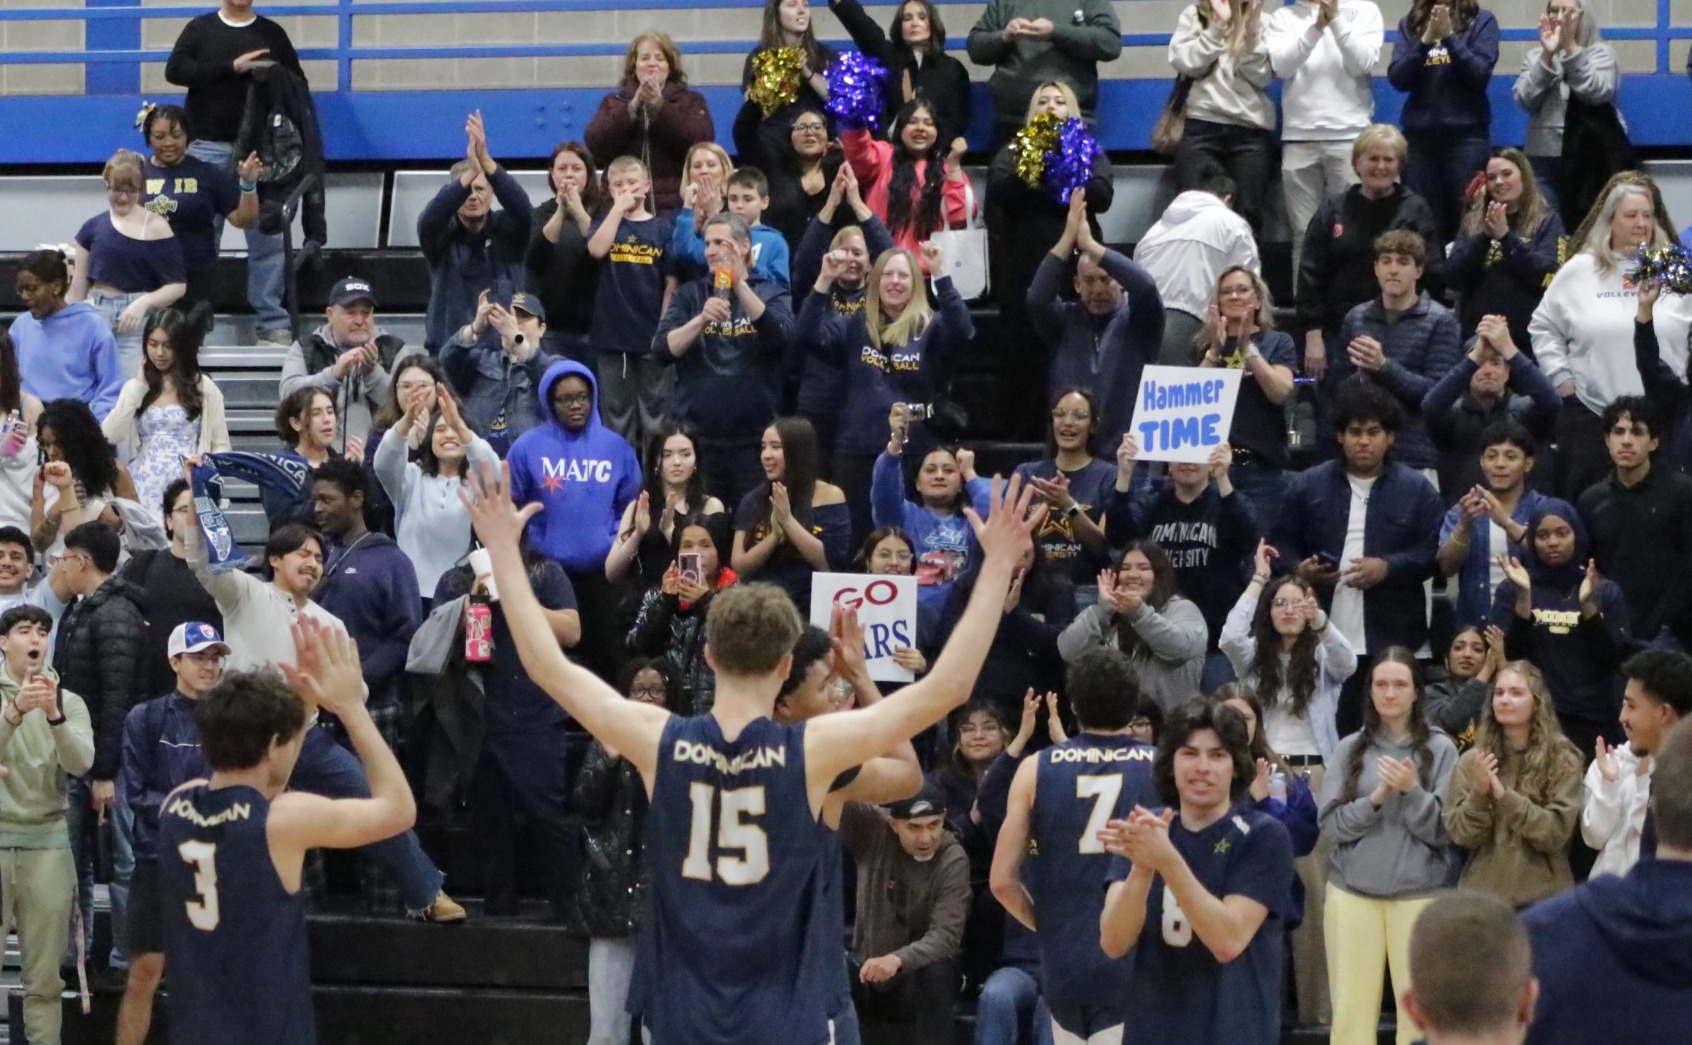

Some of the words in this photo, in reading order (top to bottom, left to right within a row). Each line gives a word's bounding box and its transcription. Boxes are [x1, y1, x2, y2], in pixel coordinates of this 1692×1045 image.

[611, 243, 663, 258] OMINICAN
[345, 282, 370, 292] SOX
[1143, 379, 1225, 412] Hammer
[1138, 413, 1221, 453] TIME
[541, 456, 612, 483] MATC
[832, 579, 899, 610] GO
[1051, 747, 1154, 765] DOMINICAN
[1076, 773, 1124, 855] 7
[682, 781, 771, 887] 15
[178, 839, 220, 932] 3
